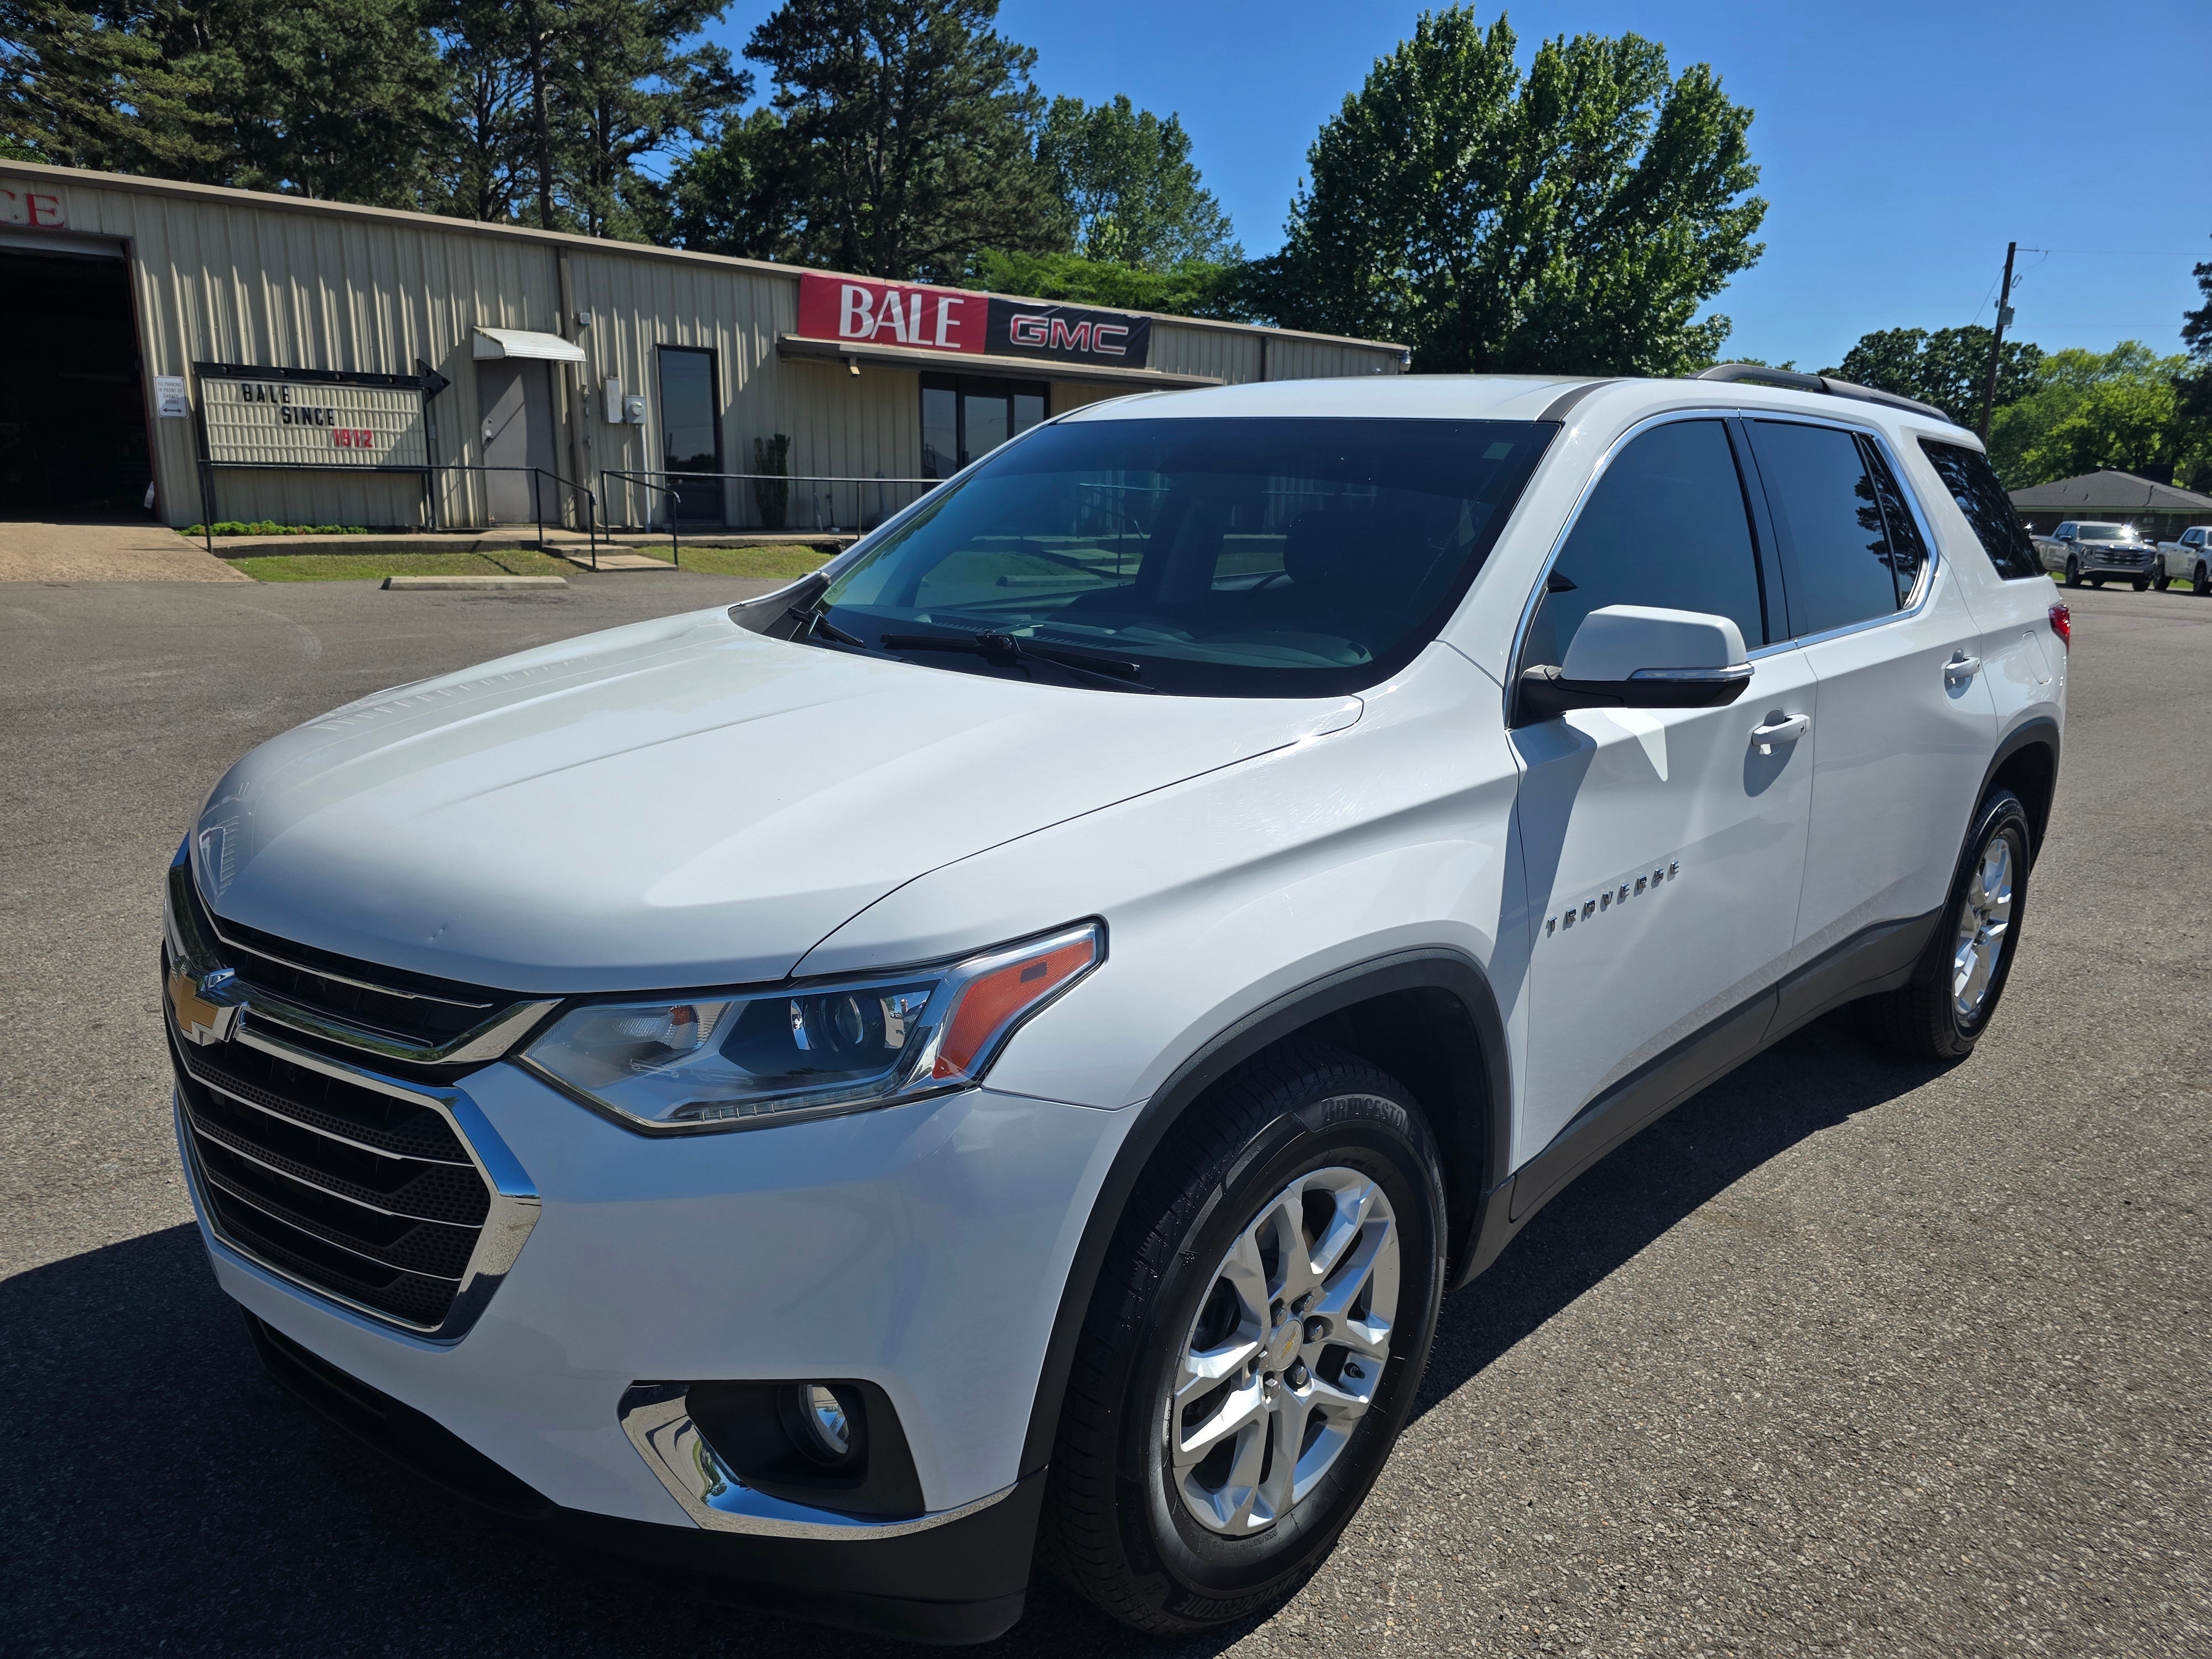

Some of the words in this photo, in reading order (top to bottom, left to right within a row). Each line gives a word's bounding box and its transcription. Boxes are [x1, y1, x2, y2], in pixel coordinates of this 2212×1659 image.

[839, 284, 964, 348] BALE
[1010, 314, 1129, 356] GMC
[242, 383, 290, 403] BALE
[281, 406, 335, 426] SINCE
[333, 429, 373, 447] 1912
[1547, 859, 1679, 933] TRAVERSE
[1322, 1097, 1416, 1142] BRIDGESTONE
